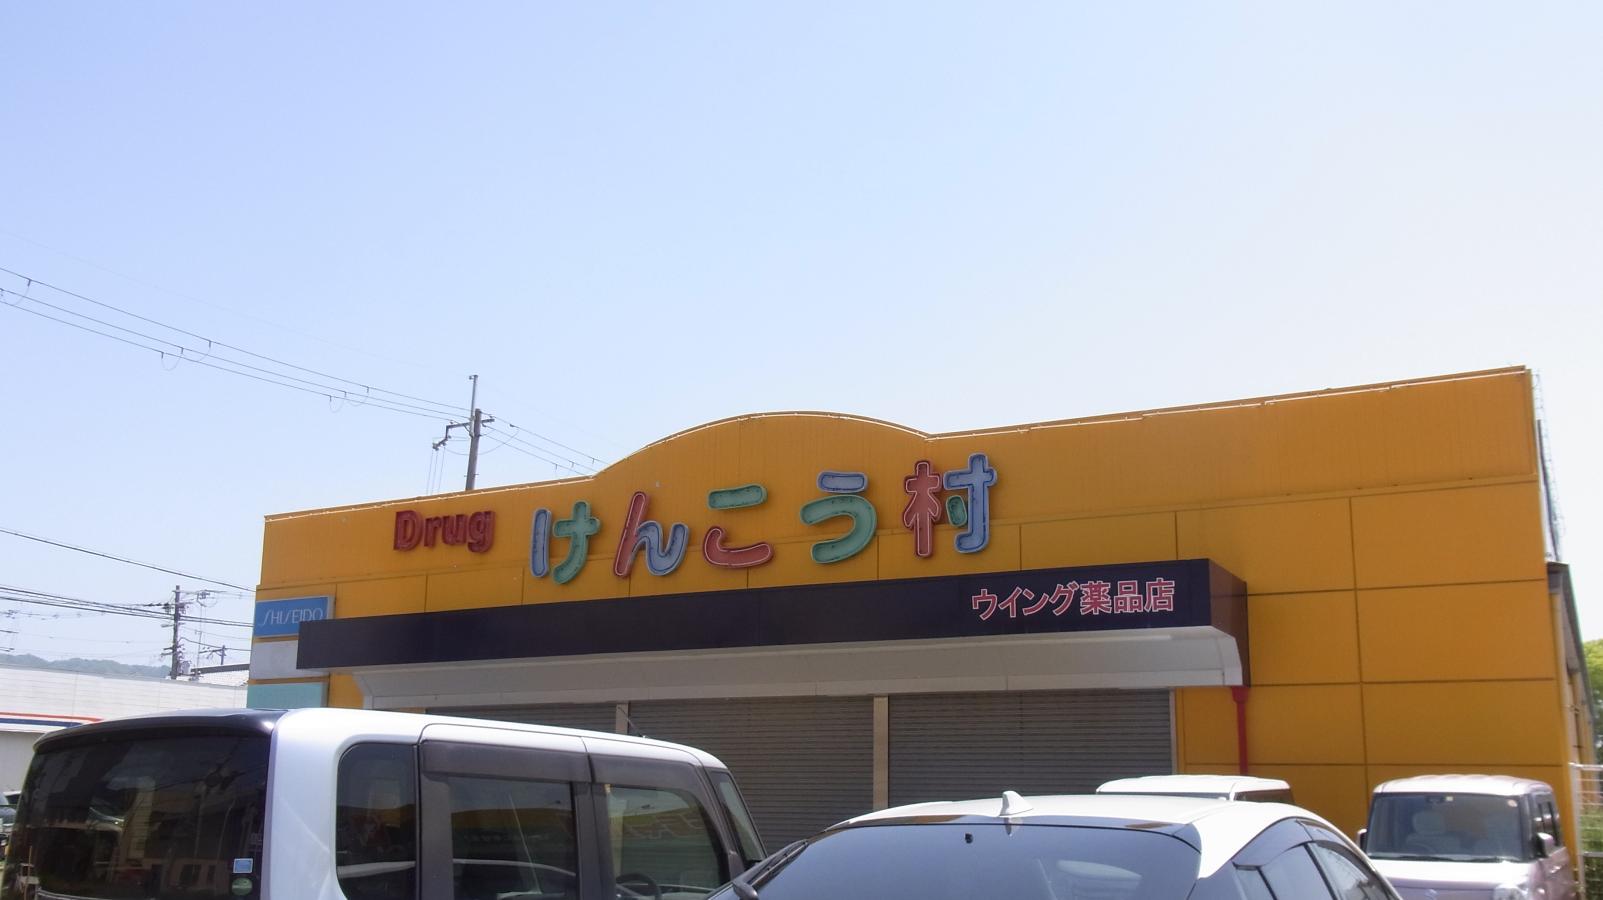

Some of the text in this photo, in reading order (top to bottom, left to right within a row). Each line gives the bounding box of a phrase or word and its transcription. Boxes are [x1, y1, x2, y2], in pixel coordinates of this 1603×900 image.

[393, 453, 997, 585] Drug けんこう村
[260, 607, 323, 626] SHISEIDO
[972, 578, 1176, 621] ウイング薬品店
